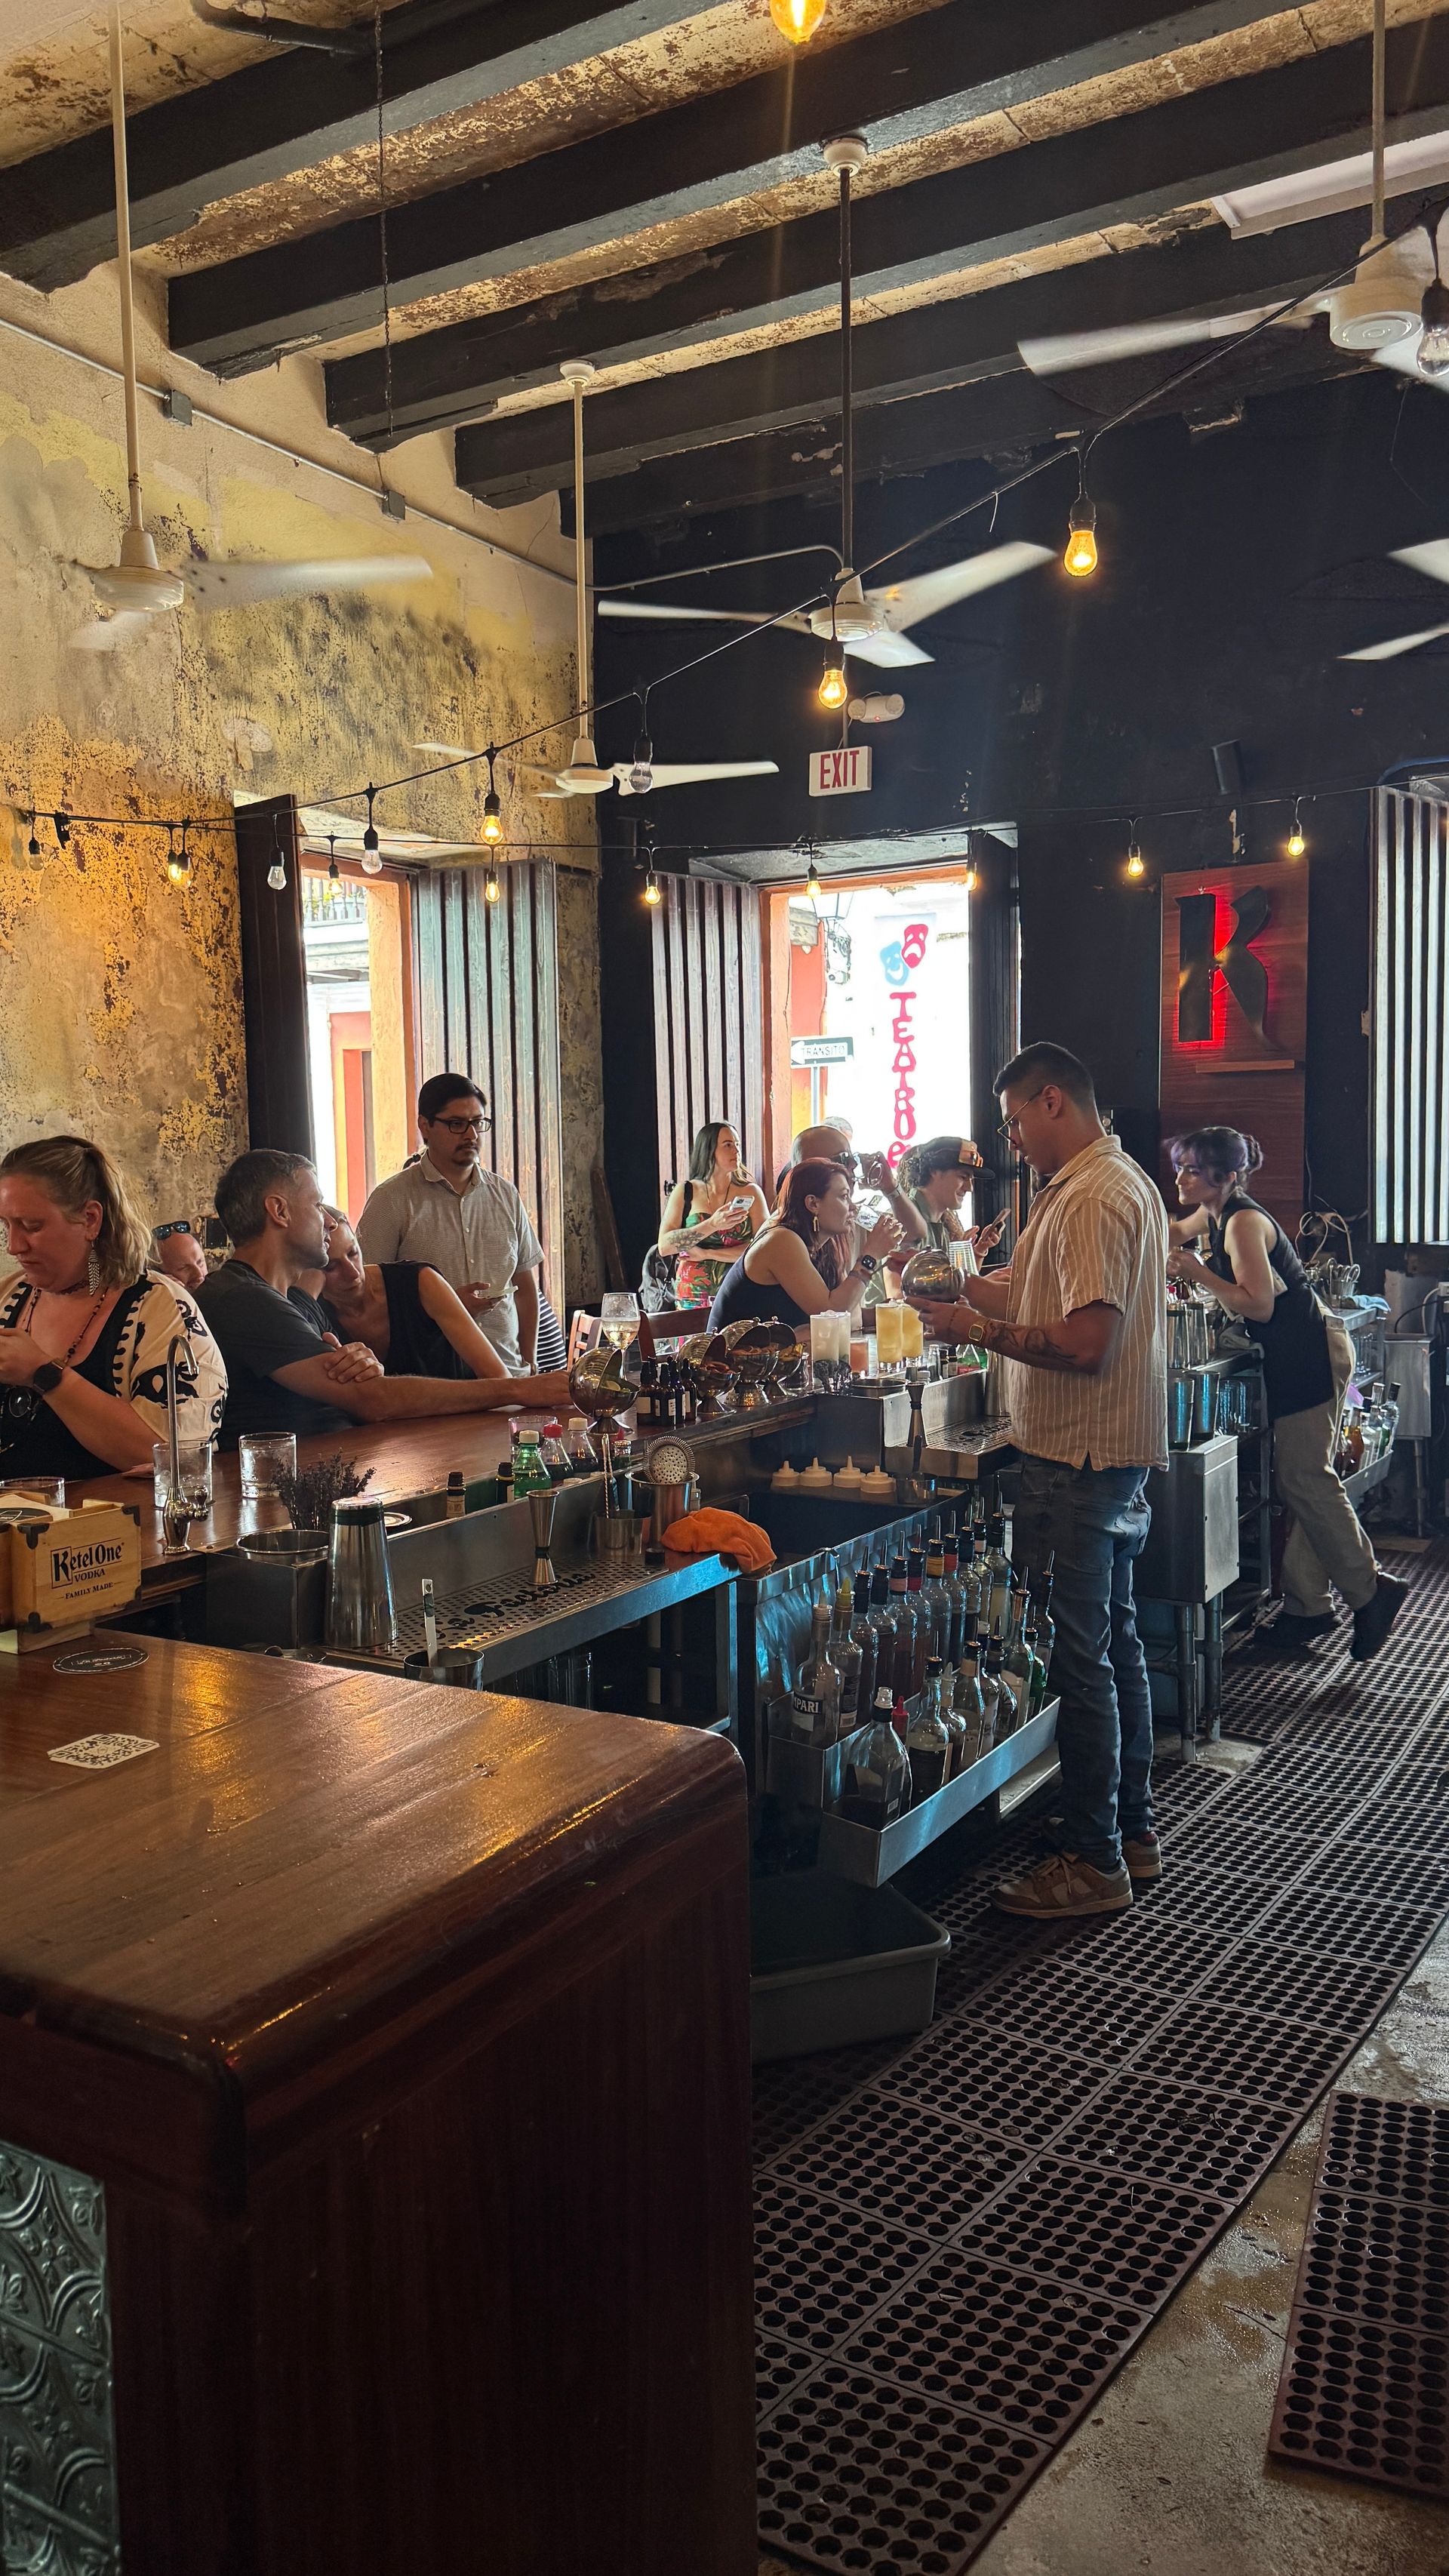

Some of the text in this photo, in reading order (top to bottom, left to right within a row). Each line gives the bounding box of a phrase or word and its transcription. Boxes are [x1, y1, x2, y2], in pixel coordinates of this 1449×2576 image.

[820, 749, 860, 789] EXIT
[801, 1045, 845, 1057] TRANSITO
[890, 991, 917, 1140] TEATRO
[53, 1543, 122, 1582] Ketel One
[74, 1568, 106, 1583] VODKA
[65, 1581, 114, 1599] FAMILY MADE
[794, 1697, 820, 1713] PARI
